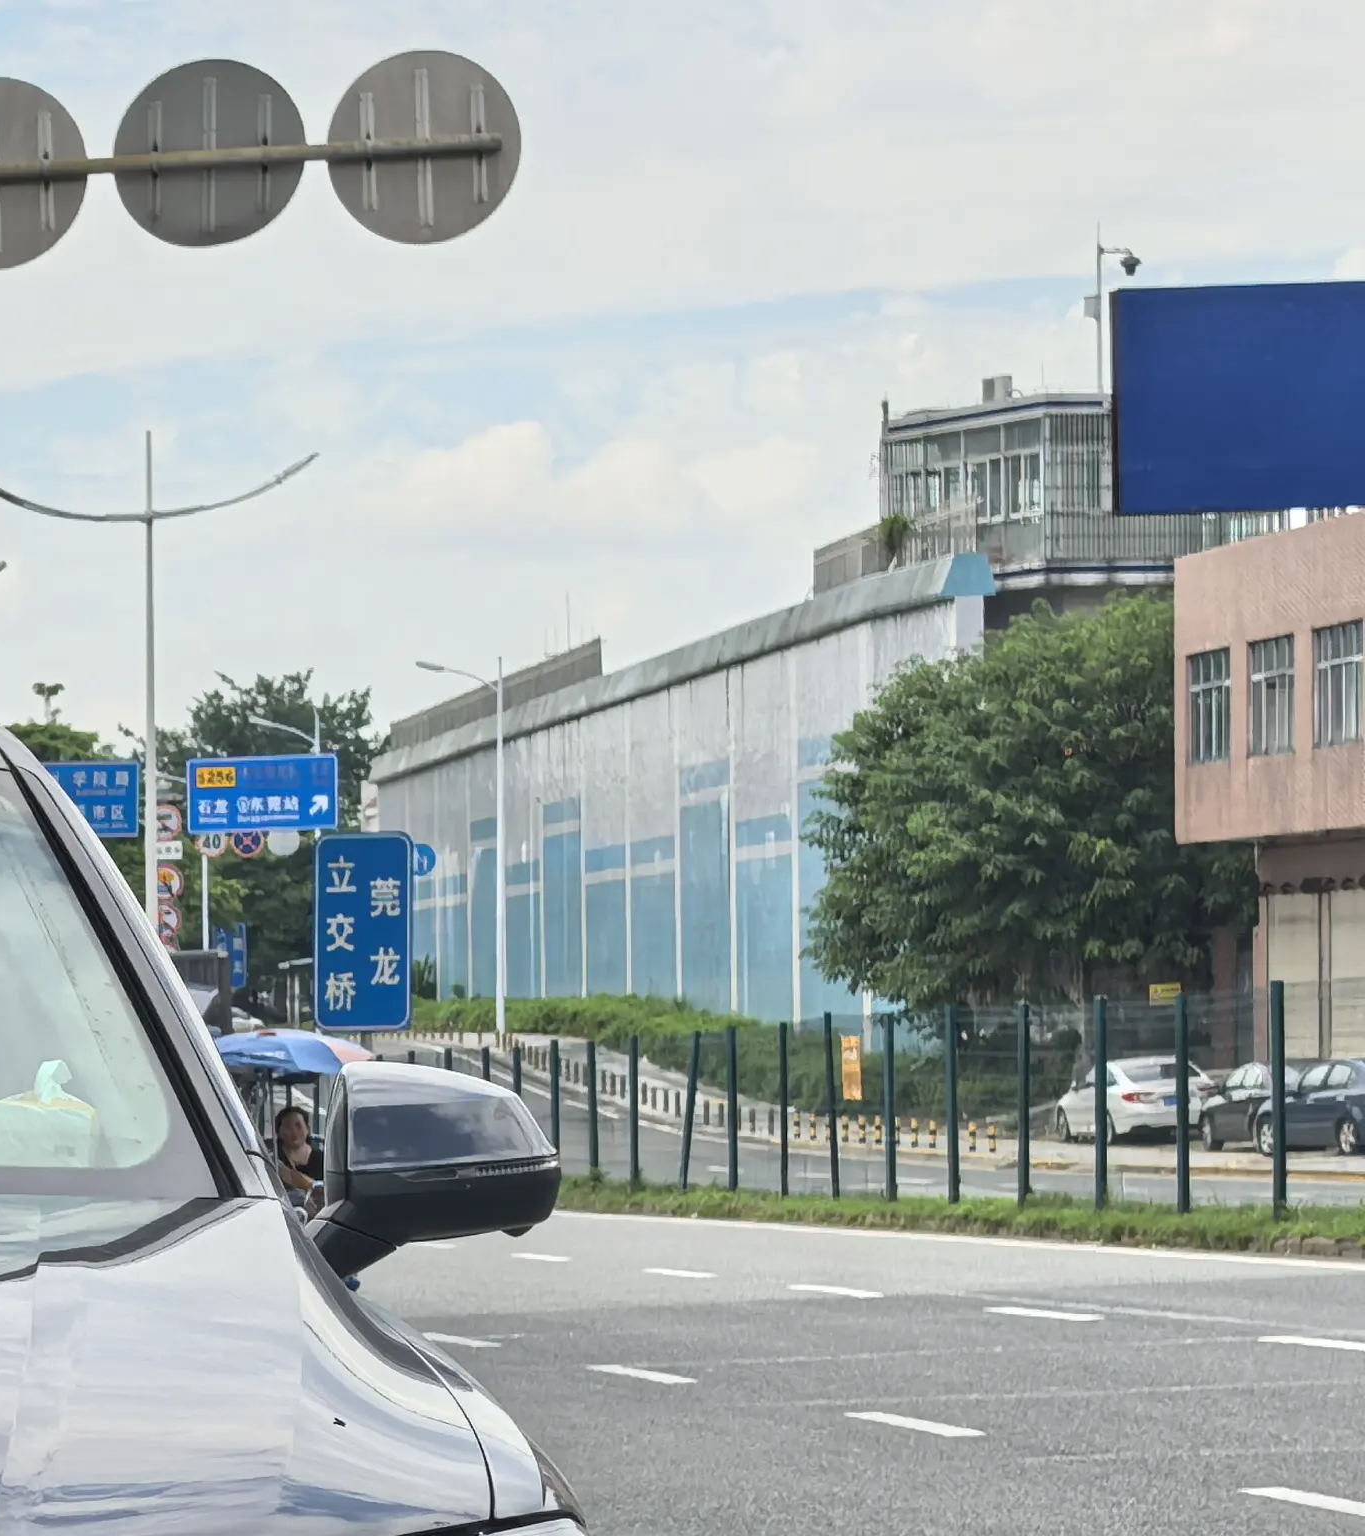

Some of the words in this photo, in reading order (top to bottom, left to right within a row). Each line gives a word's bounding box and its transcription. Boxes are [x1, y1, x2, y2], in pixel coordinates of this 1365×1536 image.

[202, 834, 221, 849] 40
[325, 856, 357, 1011] 立交桥
